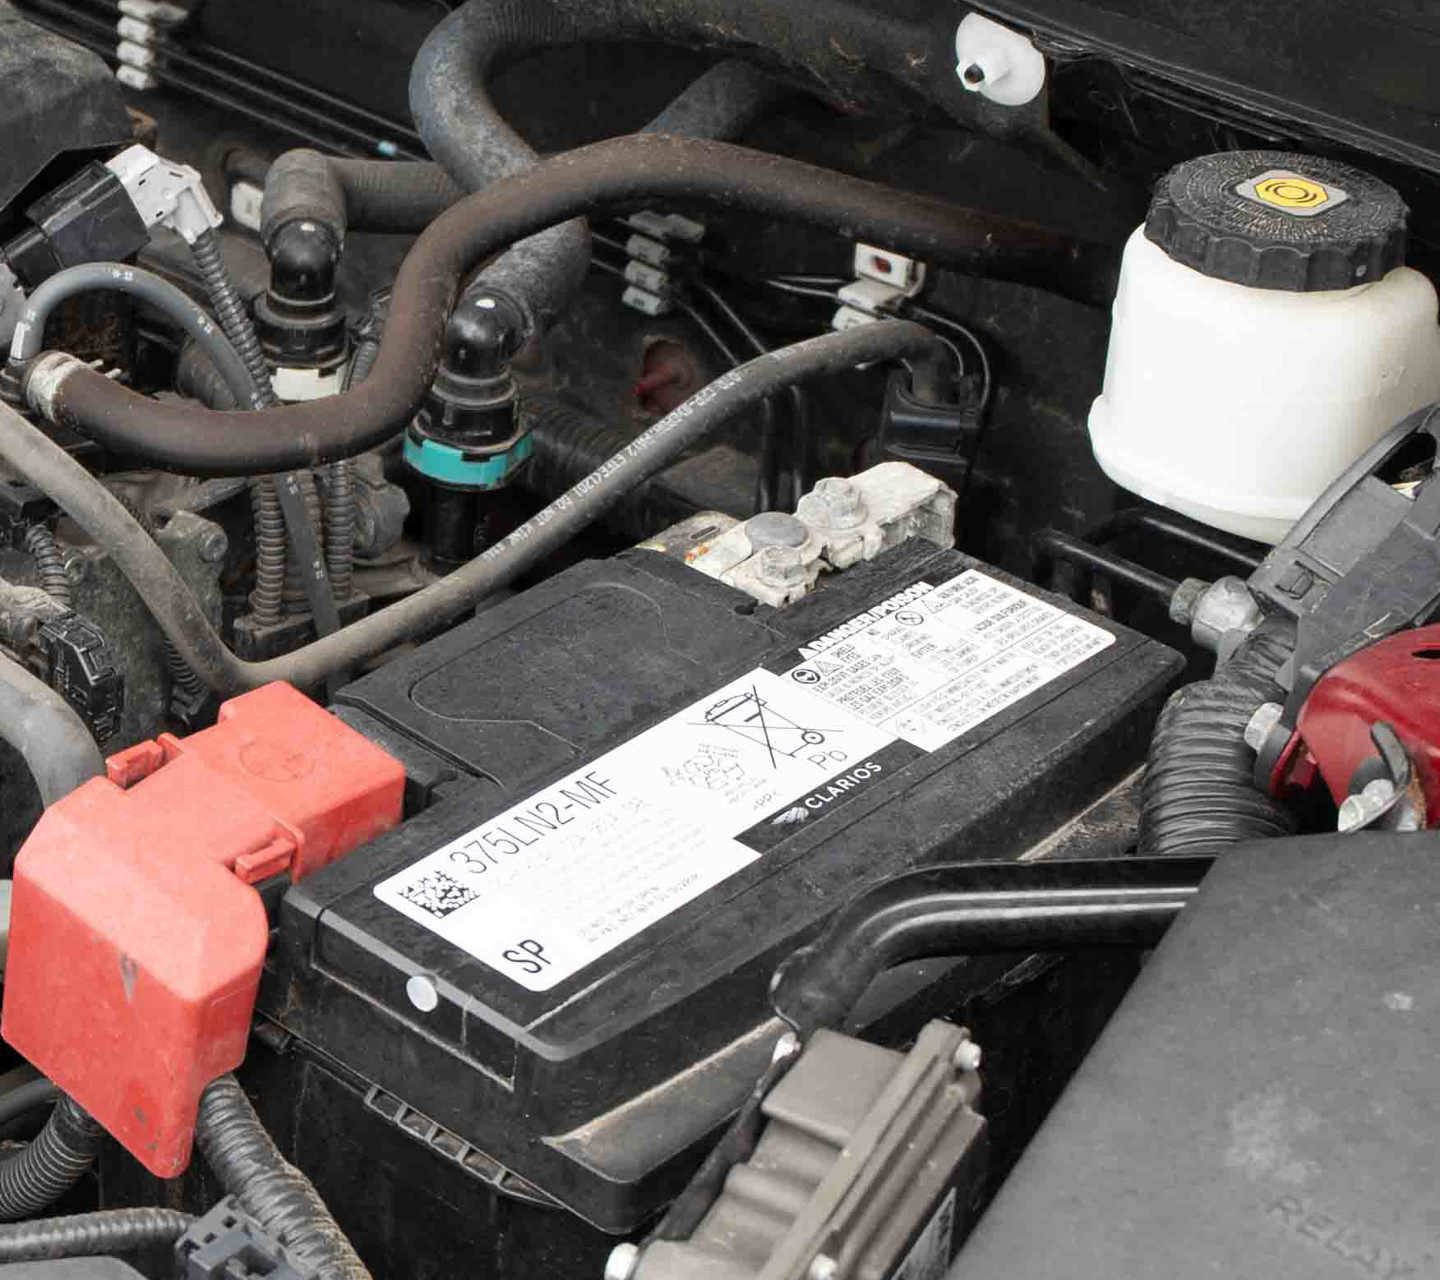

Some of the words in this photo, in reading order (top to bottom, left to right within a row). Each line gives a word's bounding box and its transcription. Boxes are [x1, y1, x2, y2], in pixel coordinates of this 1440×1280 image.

[805, 761, 883, 810] CLARIOS
[449, 771, 618, 874] 375LN2-MF
[503, 938, 552, 975] SP
